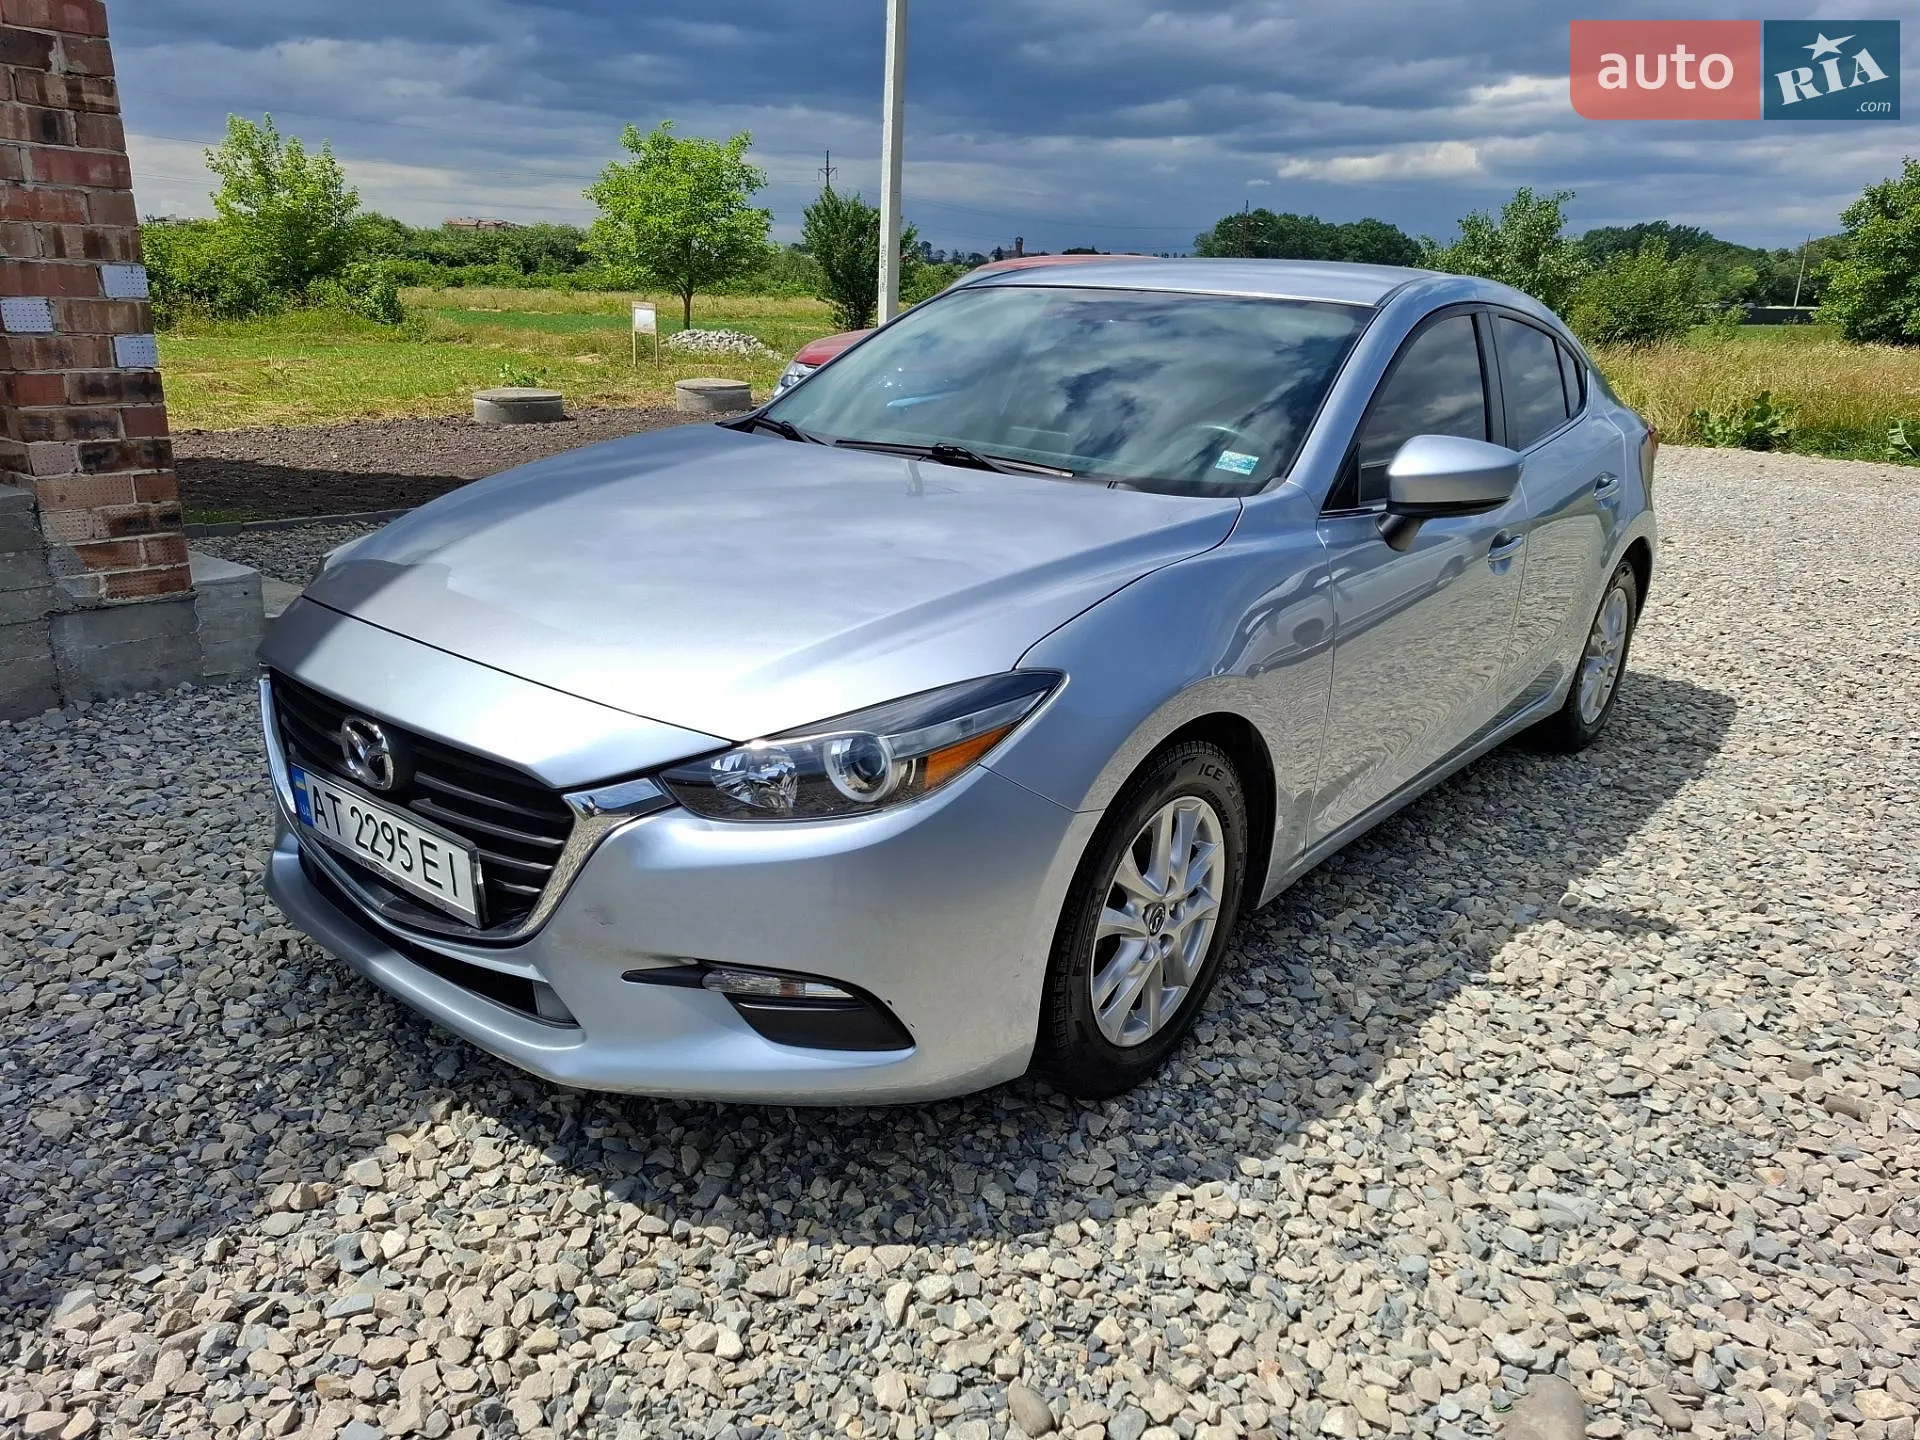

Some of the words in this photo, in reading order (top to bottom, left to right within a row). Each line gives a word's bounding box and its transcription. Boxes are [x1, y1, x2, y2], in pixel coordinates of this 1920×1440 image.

[1198, 763, 1224, 781] ICE
[312, 784, 341, 836] AT
[350, 806, 414, 873] 2295
[419, 837, 459, 898] EI
